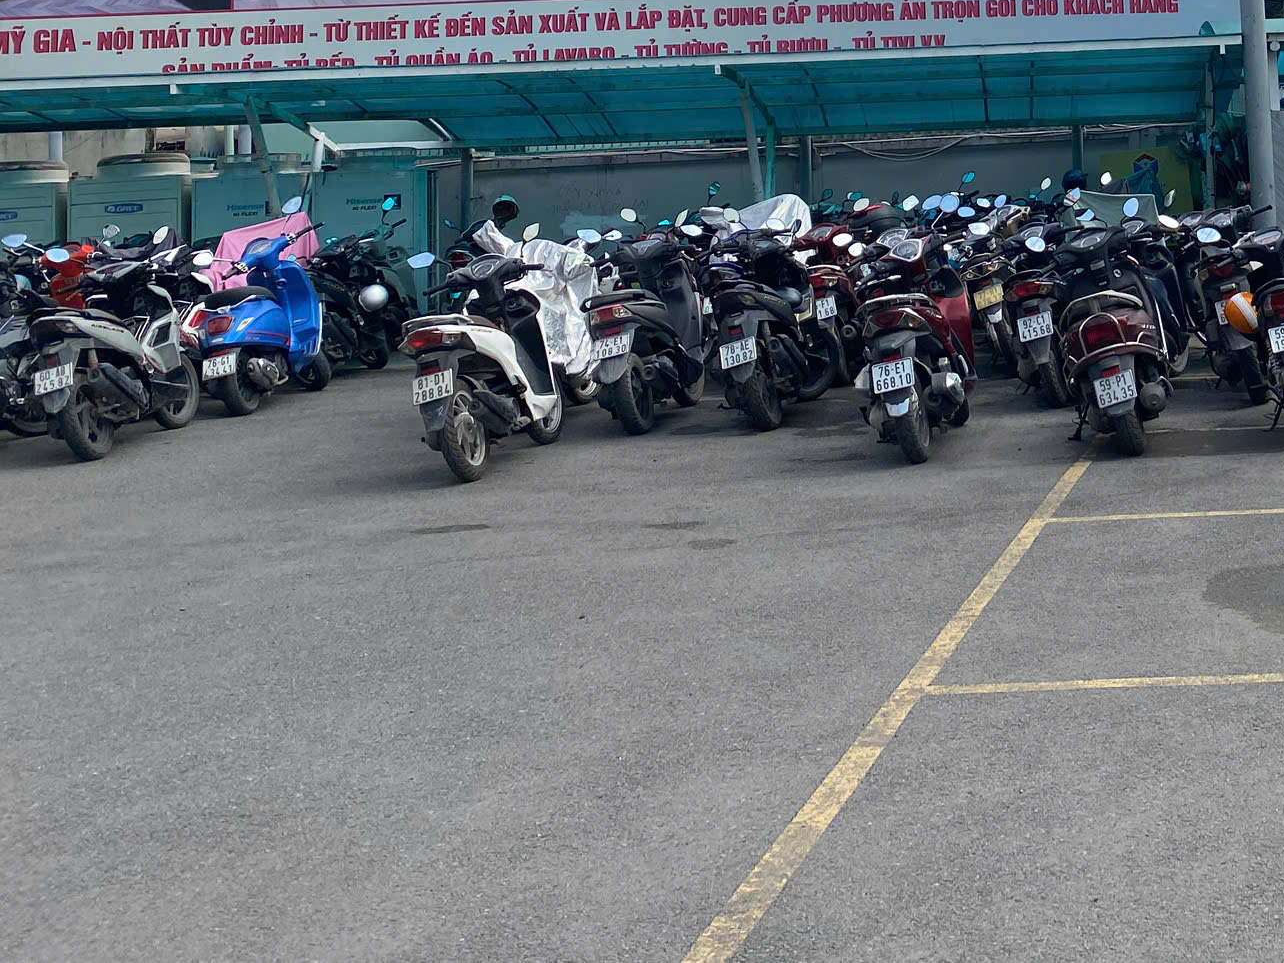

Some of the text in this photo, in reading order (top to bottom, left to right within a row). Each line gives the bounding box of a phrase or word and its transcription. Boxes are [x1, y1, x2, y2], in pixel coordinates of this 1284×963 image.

[33, 28, 77, 53] GIA
[97, 26, 134, 55] NỘI
[140, 21, 191, 50] THẤT
[196, 23, 235, 48] TÙY
[240, 18, 304, 46] CHỈNH
[323, 18, 351, 42] TỪ
[354, 14, 409, 40] THIẾT
[414, 12, 442, 39] KẾ
[445, 11, 486, 38] ĐẾN
[491, 9, 533, 35] SẢN
[538, 6, 589, 34] XUẤT
[594, 7, 620, 31] VÀ
[625, 3, 662, 30] LẮP
[667, 5, 708, 32] ĐẶT,
[713, 6, 767, 27] CUNG
[817, 1, 894, 23] PHƯƠNG
[931, 0, 980, 23] TRỌN
[116, 205, 138, 213] GREE
[1023, 315, 1045, 329] 92-C1
[1022, 324, 1051, 340] 415.68
[600, 336, 623, 349] 74-E1
[725, 341, 749, 355] 78-AE
[207, 356, 230, 369] 76-G1
[725, 350, 753, 367] 130.82
[878, 361, 905, 378] 76-E1
[417, 372, 445, 389] 81-D1
[876, 373, 911, 391] 668.10
[1099, 373, 1127, 392] 59-P1
[415, 384, 450, 404] 288.84
[1099, 385, 1134, 405] 634.35
